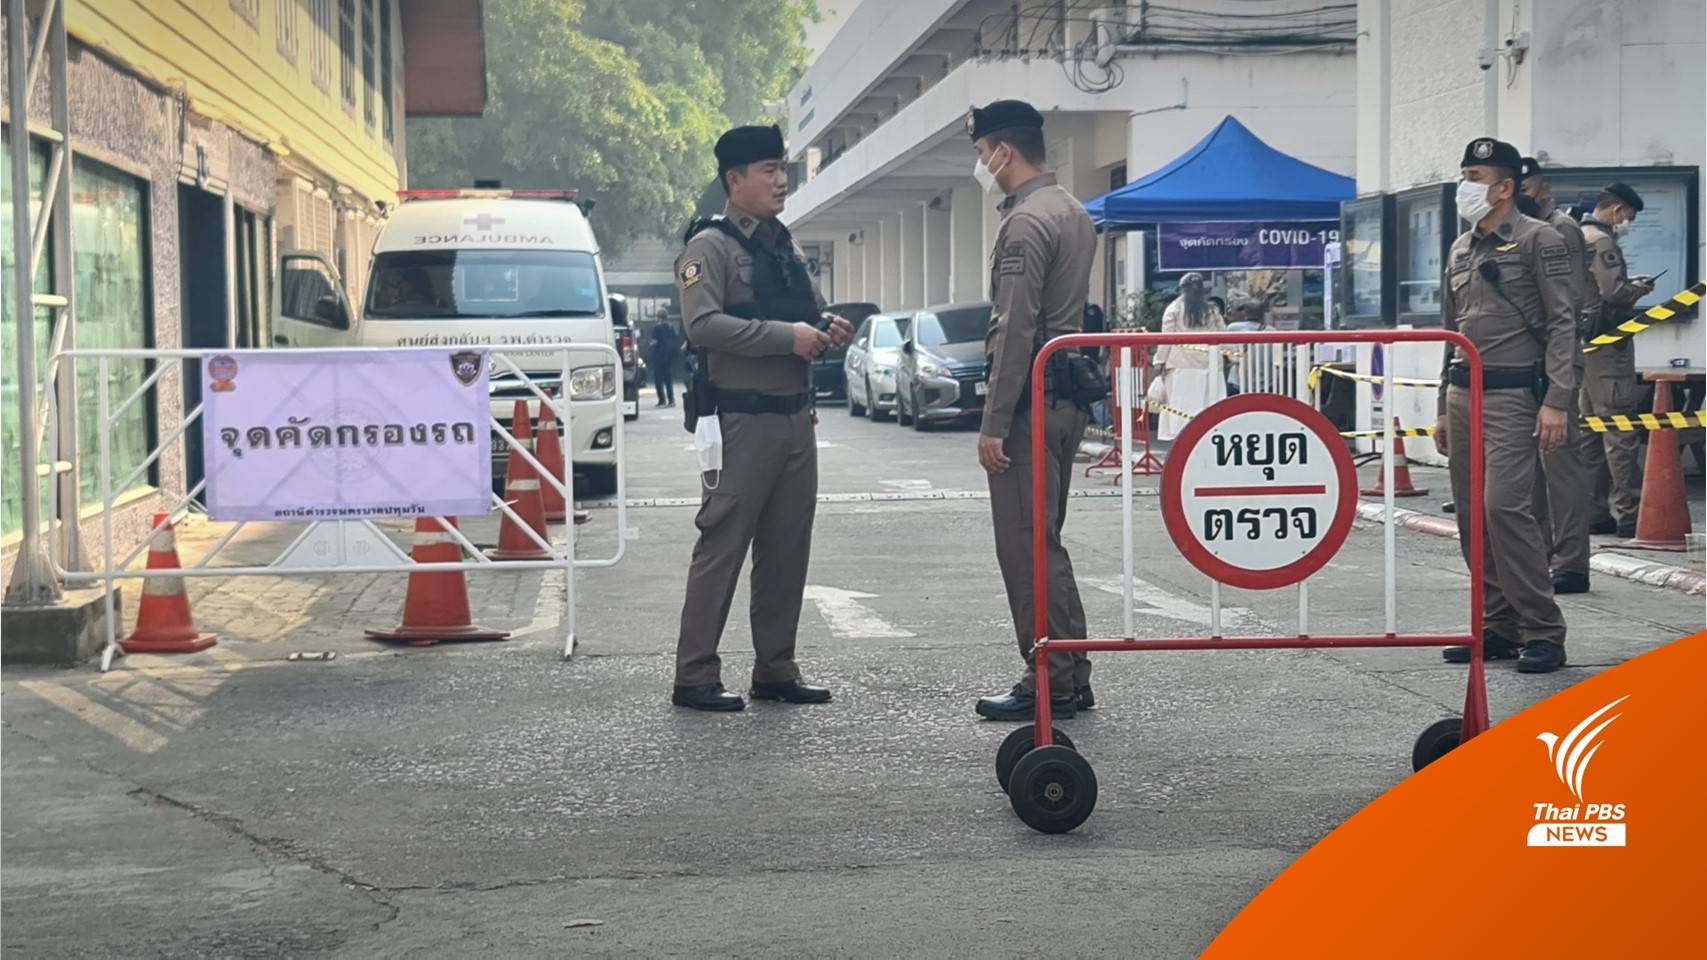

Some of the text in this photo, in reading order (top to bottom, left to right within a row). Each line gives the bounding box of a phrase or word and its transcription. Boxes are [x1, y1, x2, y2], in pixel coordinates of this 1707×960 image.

[1258, 229, 1340, 245] COVID-19
[397, 332, 491, 347] ศนย์ส่งกลับฯ
[220, 417, 475, 459] จุดคัดกรองรถ
[1211, 432, 1308, 481] หยุด
[1204, 507, 1317, 541] ตรวจ
